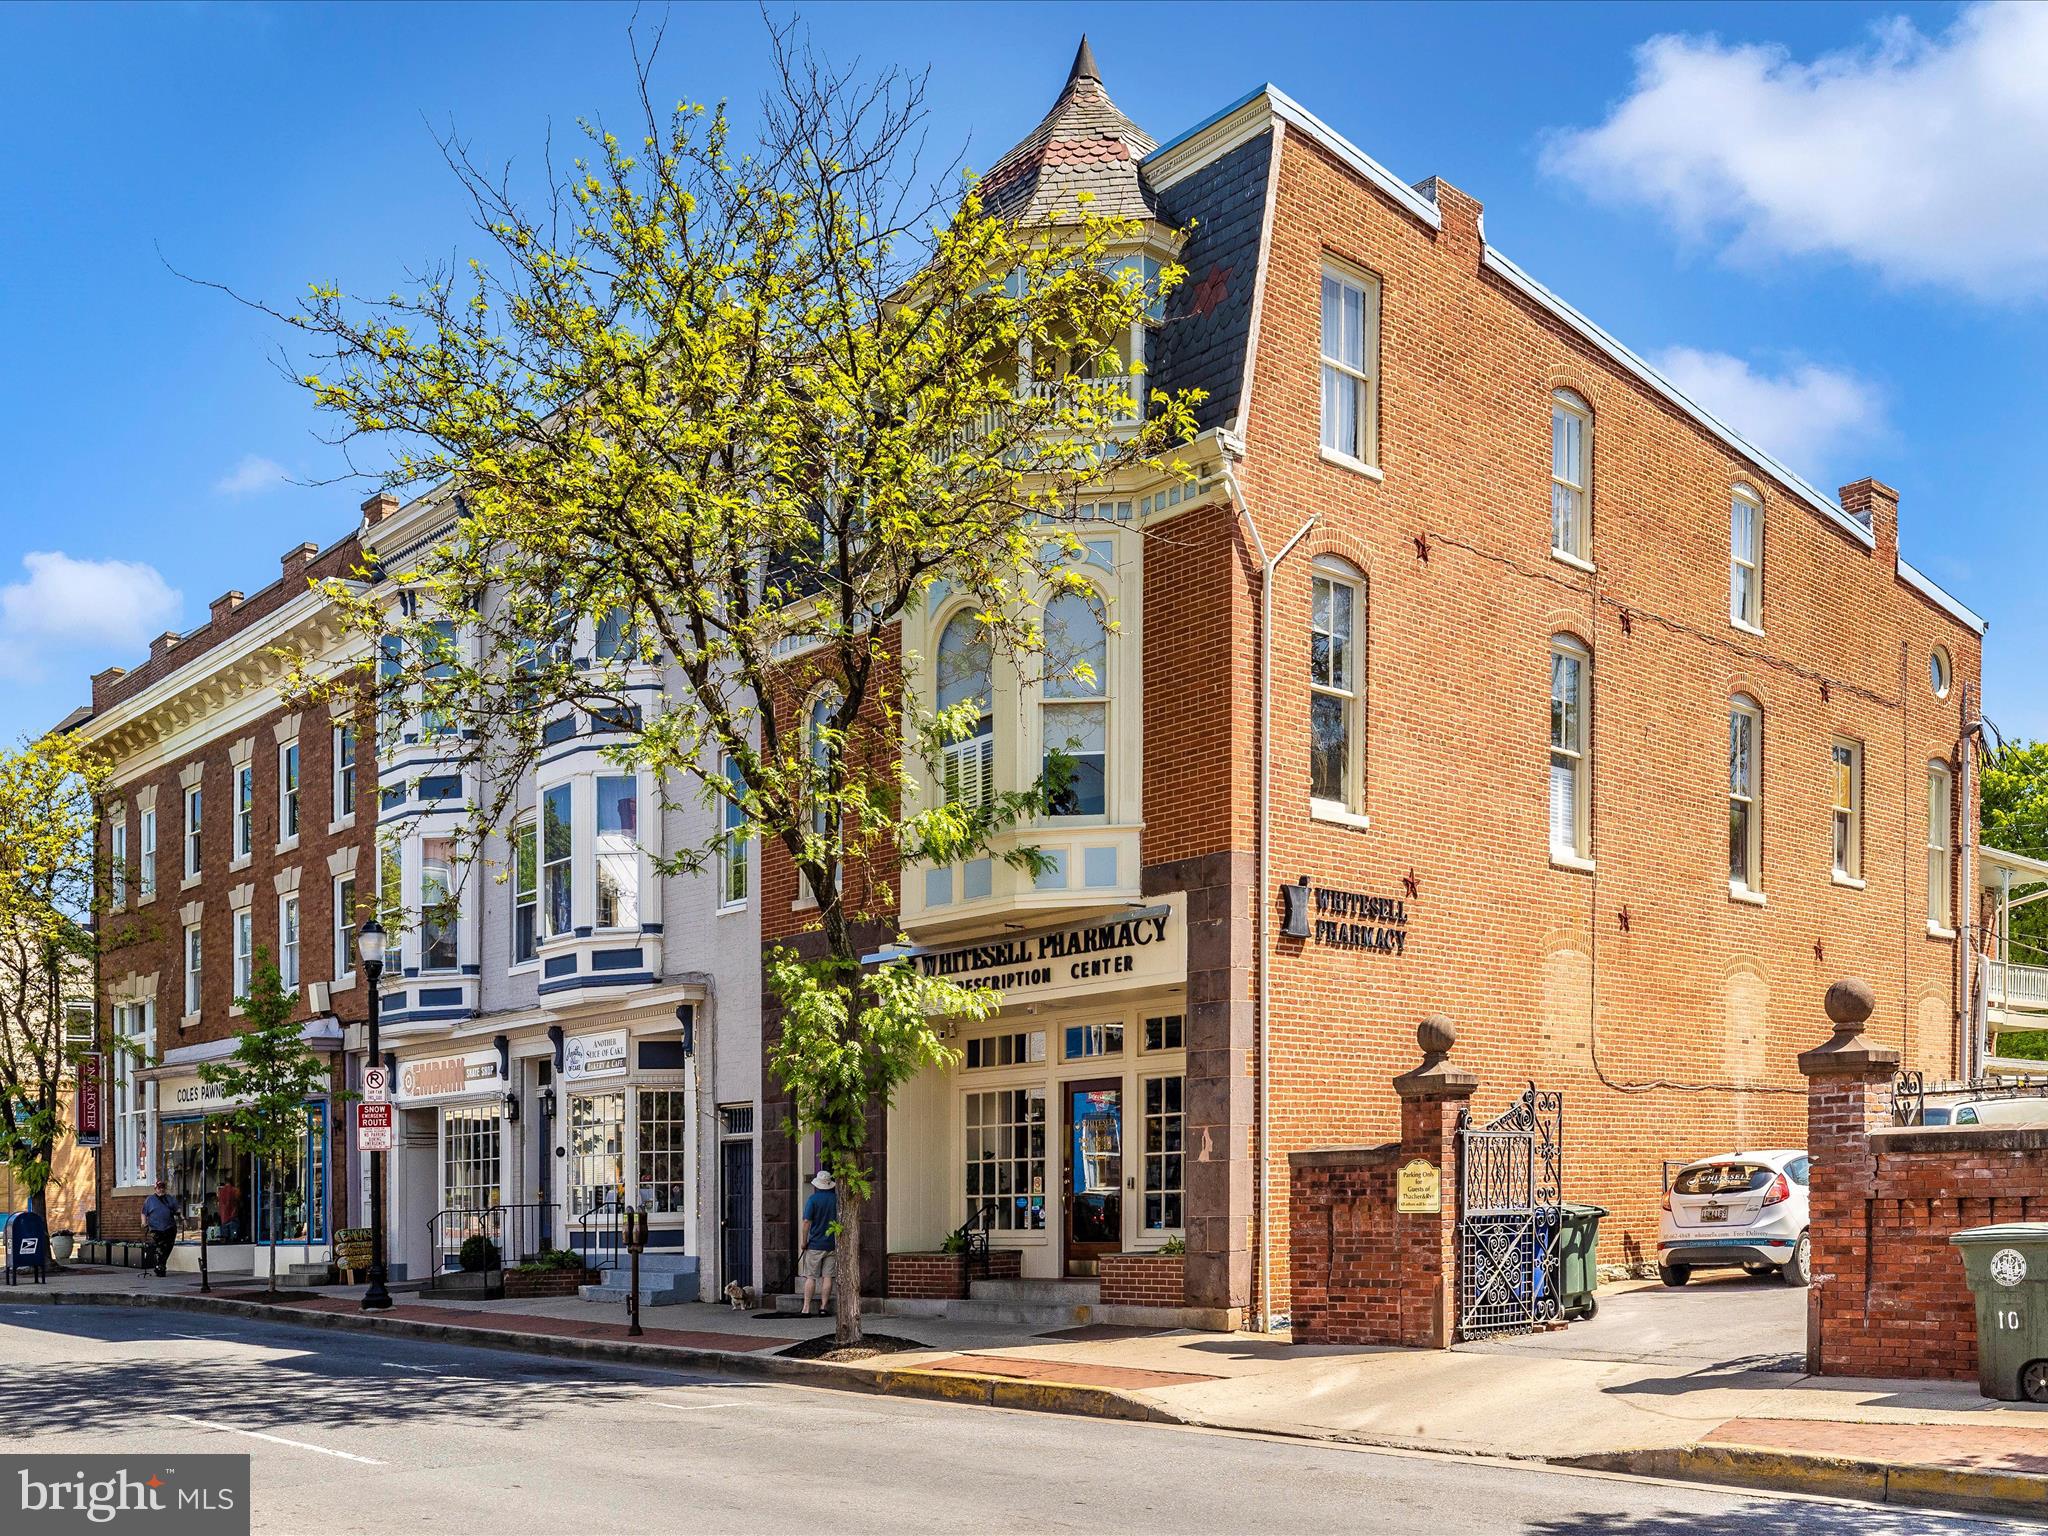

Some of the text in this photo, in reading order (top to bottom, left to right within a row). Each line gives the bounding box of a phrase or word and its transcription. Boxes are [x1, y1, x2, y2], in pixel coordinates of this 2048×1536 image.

[1315, 888, 1408, 920] WHITESELL
[922, 917, 1168, 977] WHITESELL PHARMACY
[1315, 920, 1407, 951] PHARMACY
[955, 955, 1134, 991] RESCRIPTION CENTER
[593, 1038, 616, 1048] ANOTHER
[610, 1047, 624, 1055] CAKE
[412, 1058, 465, 1096] EMBARK
[466, 1066, 494, 1078] SKATE SHOP
[177, 1086, 199, 1102] COLE'S
[87, 1093, 96, 1128] FOSTER
[1998, 1310, 2019, 1330] 10
